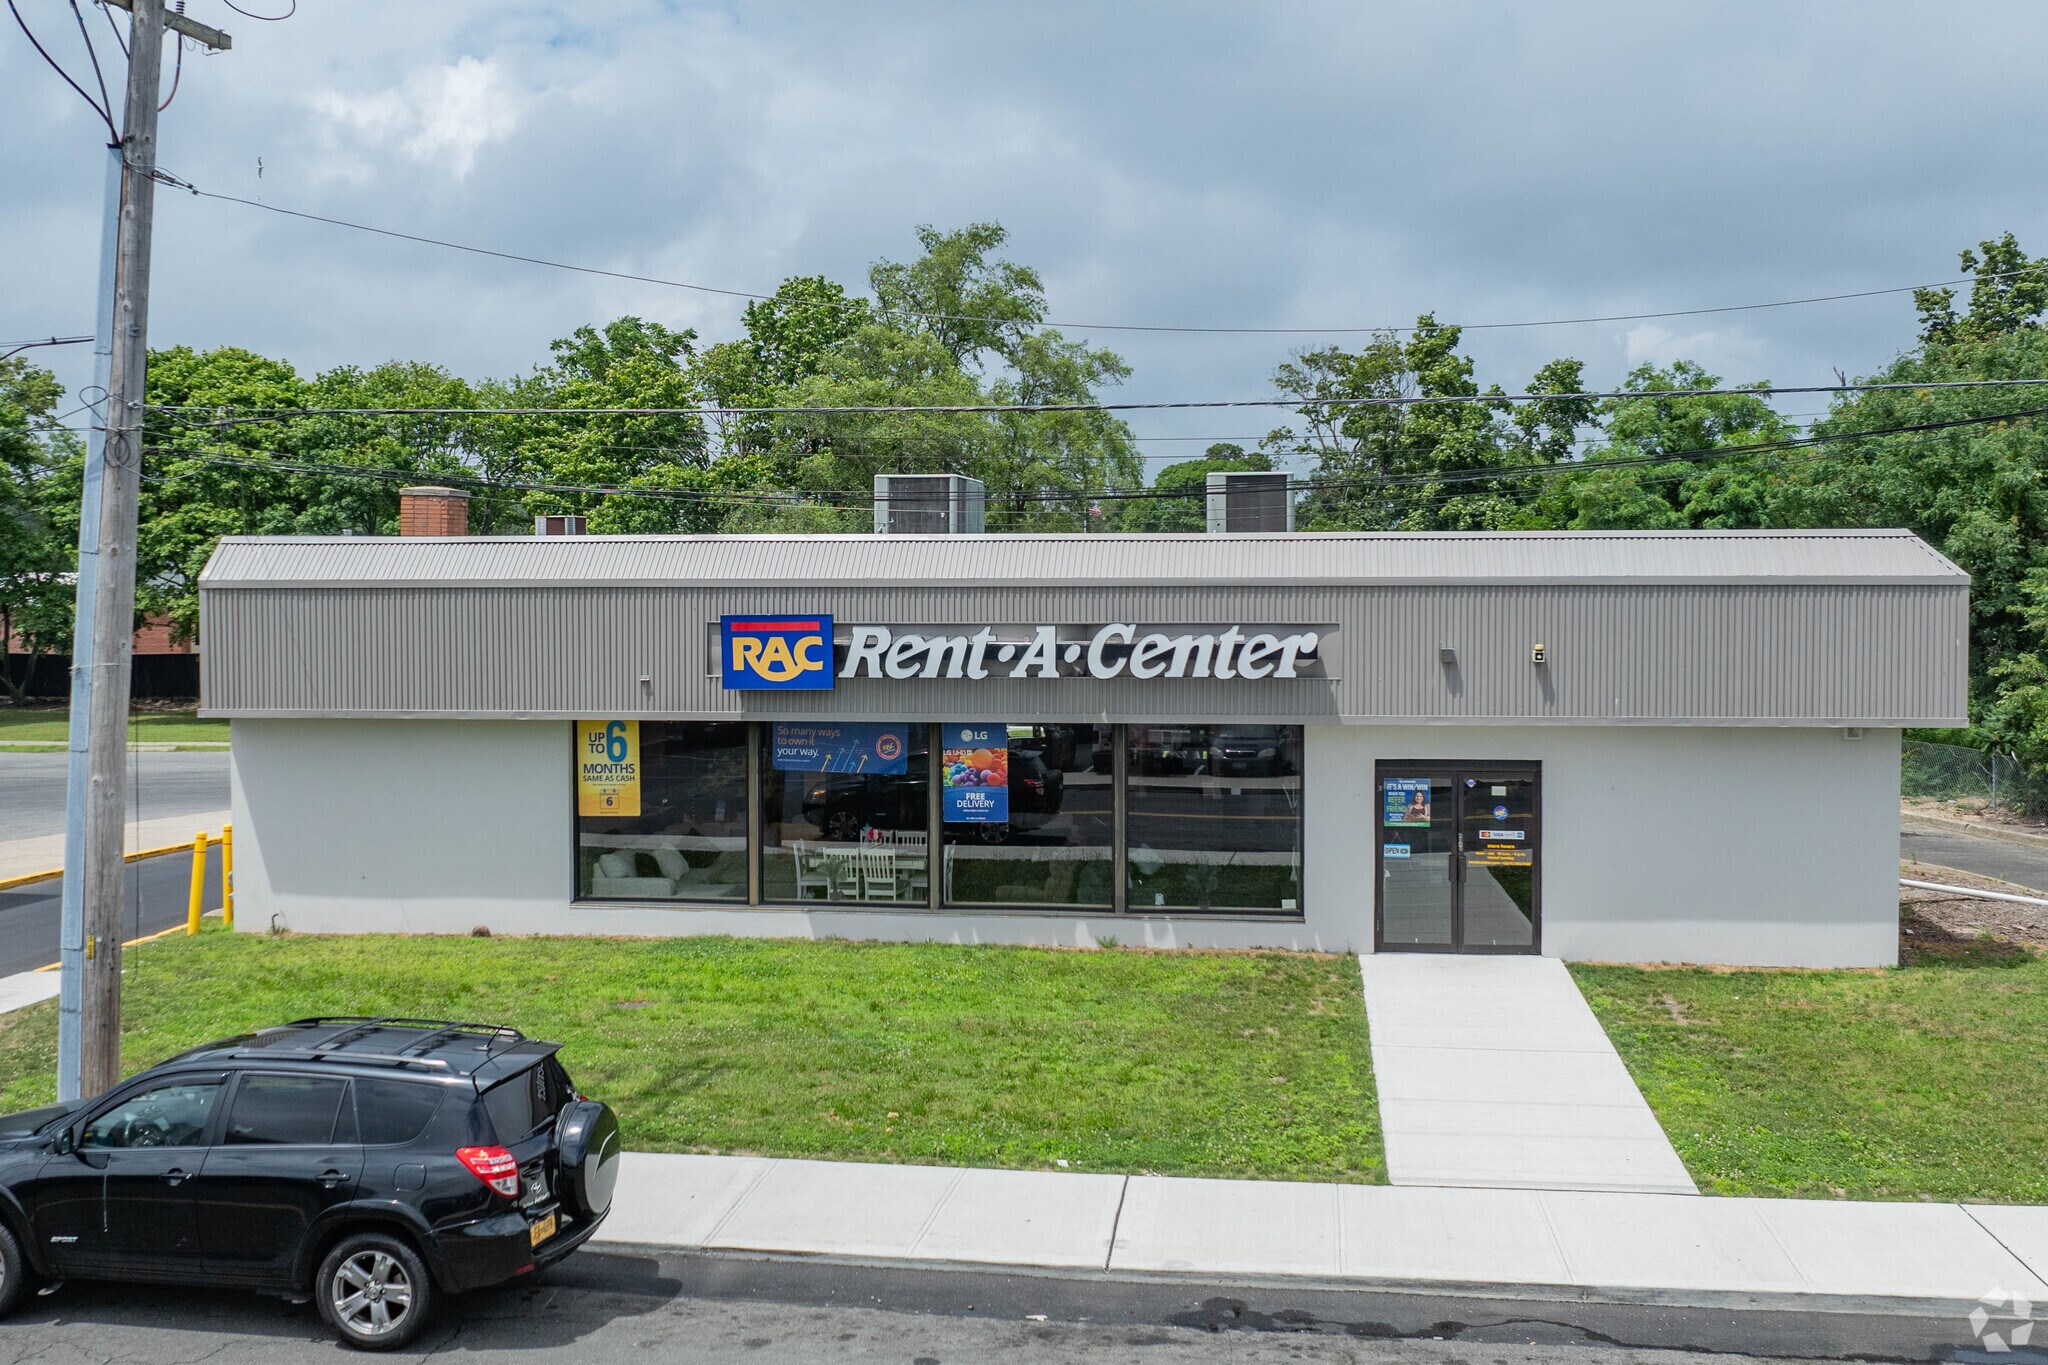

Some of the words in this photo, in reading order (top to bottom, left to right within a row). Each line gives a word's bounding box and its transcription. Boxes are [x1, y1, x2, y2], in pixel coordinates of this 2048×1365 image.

[732, 636, 823, 682] RAC
[589, 732, 605, 742] UP
[777, 726, 789, 735] So
[790, 728, 817, 738] many
[818, 729, 841, 738] ways
[974, 731, 988, 740] LG
[606, 720, 627, 762] 6
[777, 737, 787, 745] to
[809, 737, 815, 746] it
[589, 743, 605, 753] TO
[777, 747, 798, 757] your
[800, 749, 820, 758] way.
[583, 763, 635, 774] MONTHS
[606, 796, 613, 806] 6
[956, 800, 995, 808] DELIVERY
[1385, 847, 1399, 855] OPEN
